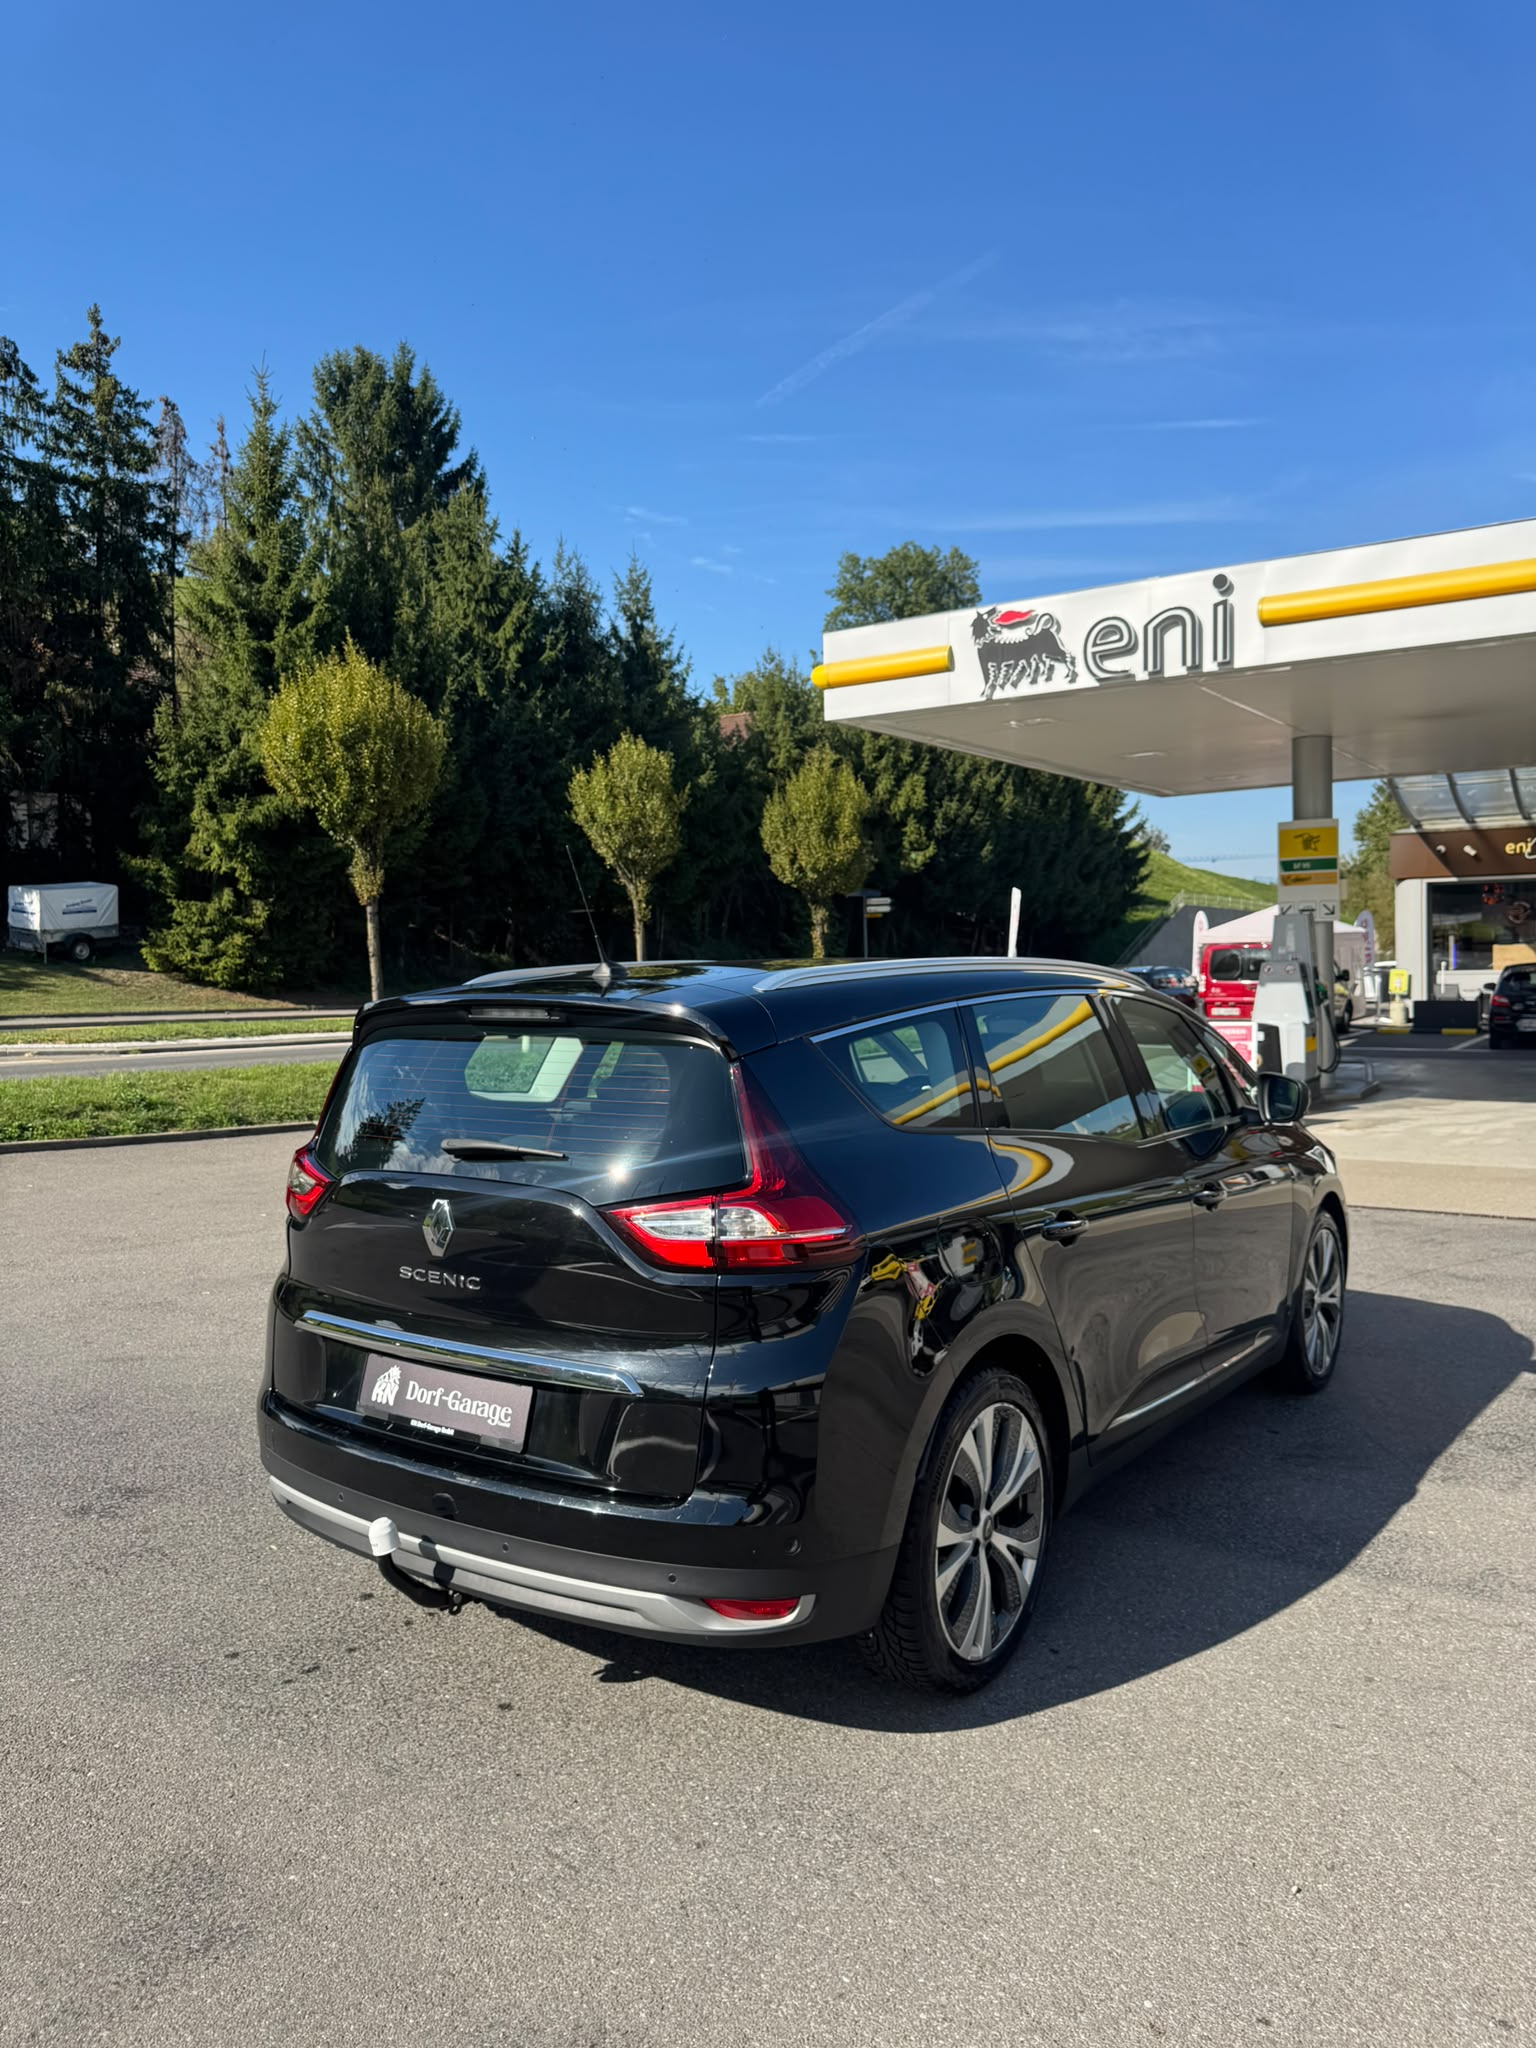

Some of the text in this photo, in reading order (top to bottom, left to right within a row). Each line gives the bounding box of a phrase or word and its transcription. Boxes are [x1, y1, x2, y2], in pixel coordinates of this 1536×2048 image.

[1083, 573, 1235, 684] eni
[1505, 838, 1532, 855] eni
[399, 1265, 481, 1290] SCENIC
[405, 1380, 513, 1427] Dorf-Garage
